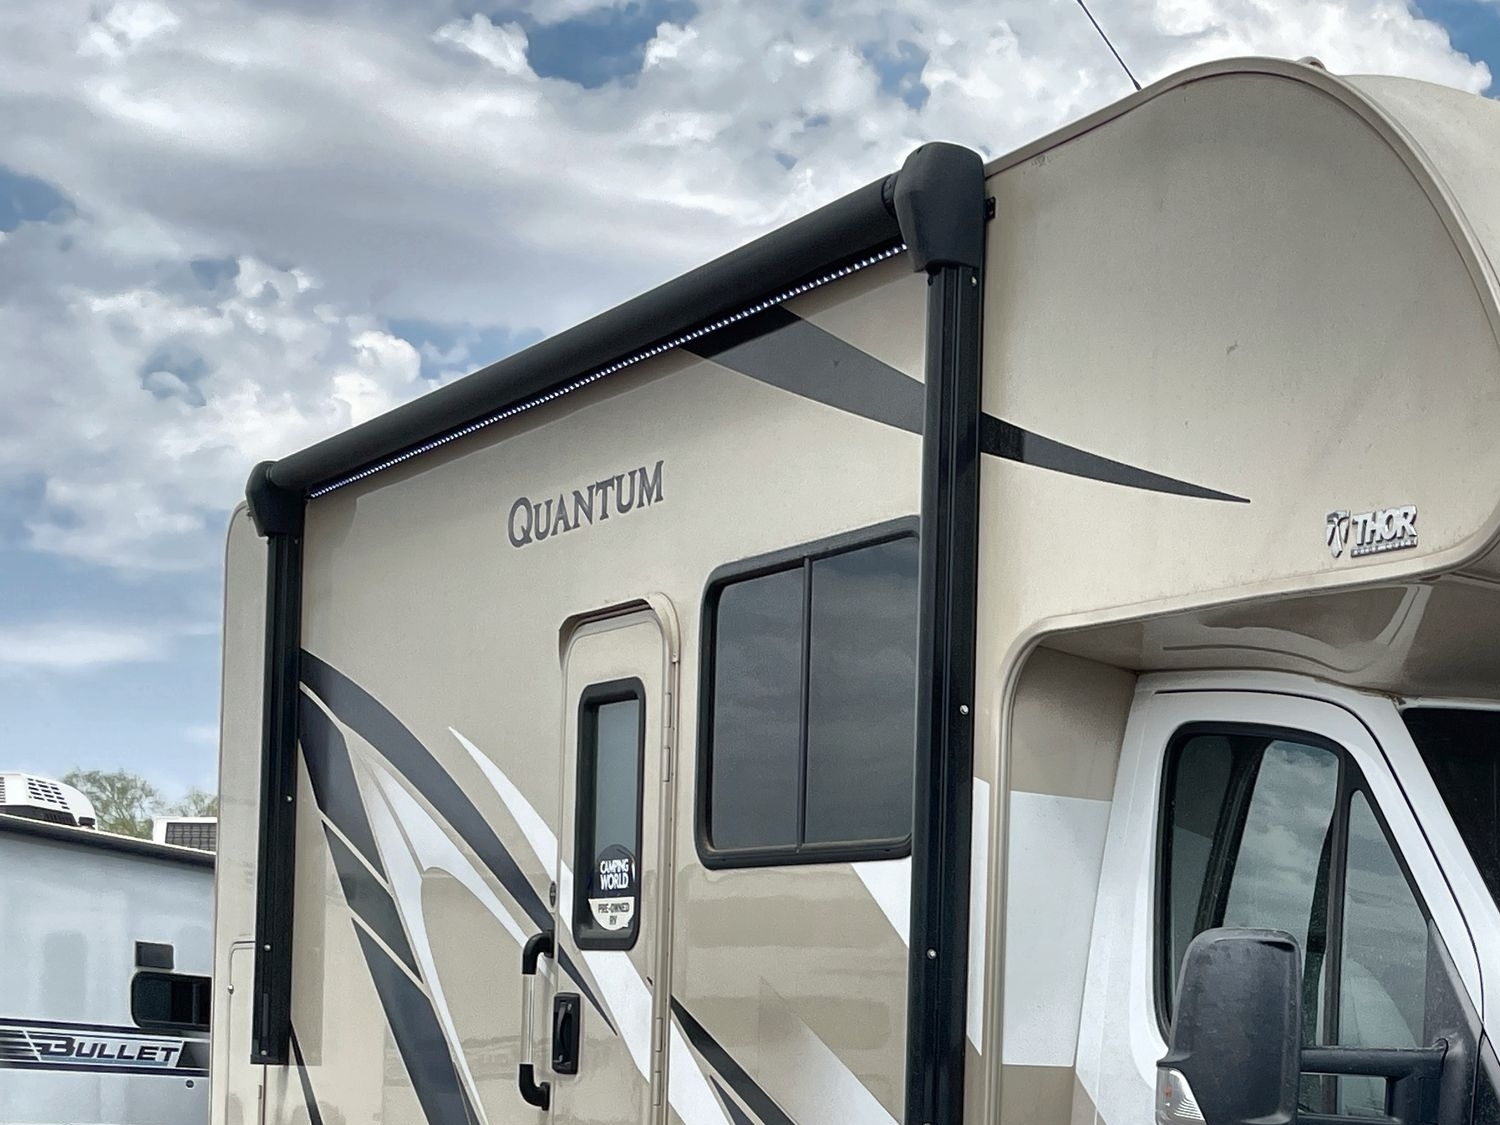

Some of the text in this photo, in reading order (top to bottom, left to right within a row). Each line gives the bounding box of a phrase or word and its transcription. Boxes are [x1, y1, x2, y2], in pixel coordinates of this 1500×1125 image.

[507, 460, 664, 548] QUANTUM
[1352, 505, 1417, 546] THOR
[600, 859, 629, 875] CAMPING
[600, 873, 629, 891] WORLD
[28, 1036, 180, 1062] BULLET
